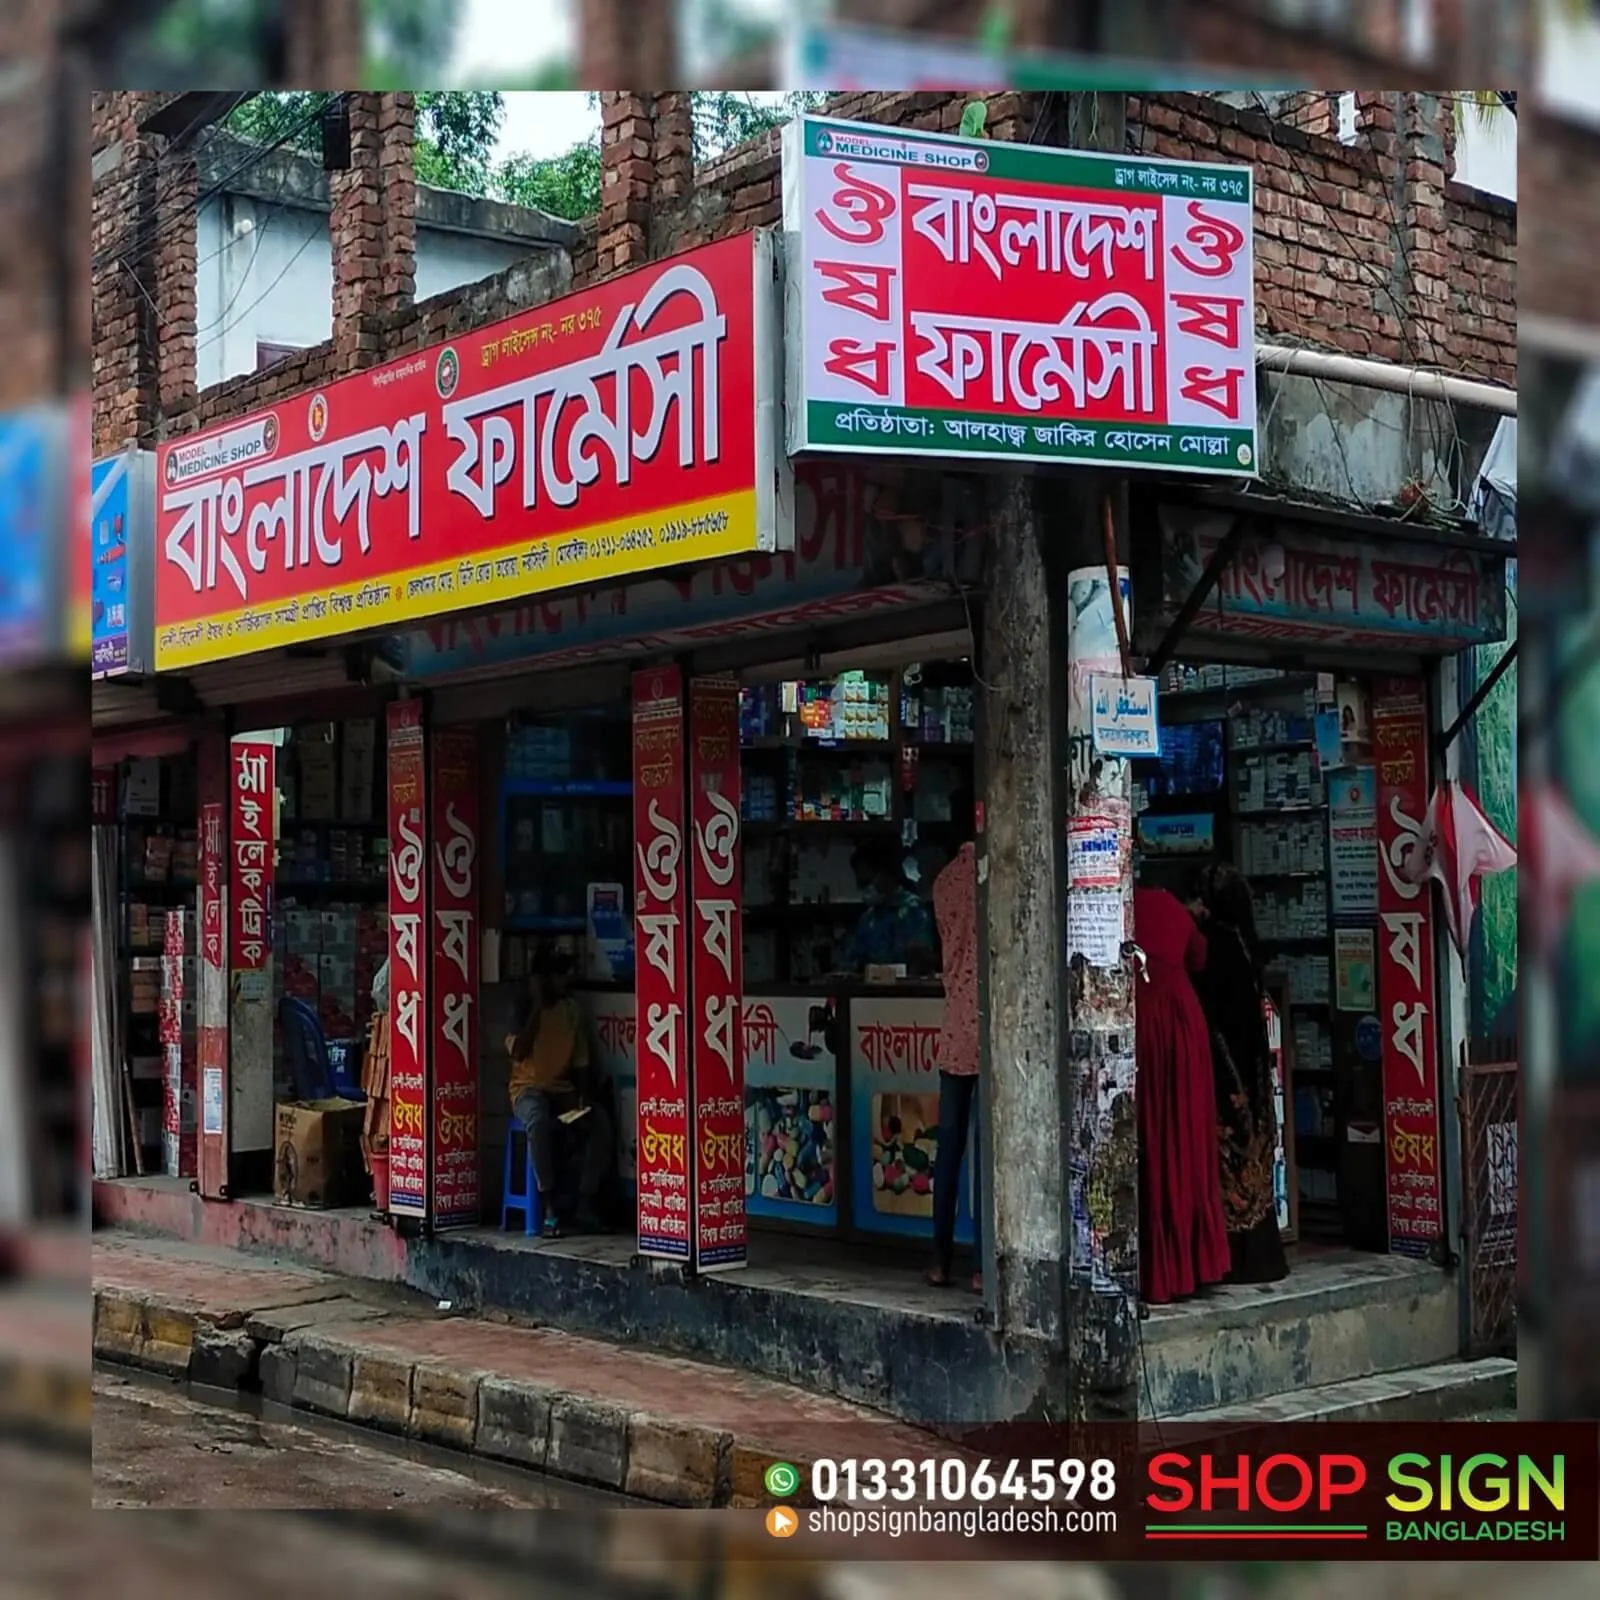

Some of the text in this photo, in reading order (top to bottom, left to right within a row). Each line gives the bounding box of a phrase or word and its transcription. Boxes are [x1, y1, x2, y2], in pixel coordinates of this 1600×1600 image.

[835, 136, 869, 145] MODEL
[835, 142, 972, 168] MEDICINE SHOP
[1219, 180, 1243, 196] ৩৭৫
[907, 183, 1158, 281] বাংলাদেশ
[578, 305, 602, 331] ৩৭৫
[909, 291, 1158, 413] ফার্মেসী
[163, 264, 727, 600] বাংলাদেশ ফার্মেসী
[179, 447, 207, 461] MODEL
[1033, 421, 1097, 448] জাকির
[1104, 429, 1171, 452] হোসেন
[1179, 435, 1230, 456] মোল্লা
[179, 440, 262, 477] MEDICINE SHOP
[234, 748, 268, 793] মা
[392, 1090, 423, 1136] ঔষধ
[438, 1102, 476, 1149] ঔষধ
[641, 1118, 686, 1172] ঔষধ
[700, 1121, 743, 1172] ঔষধ
[1390, 1117, 1435, 1169] ঔষধ
